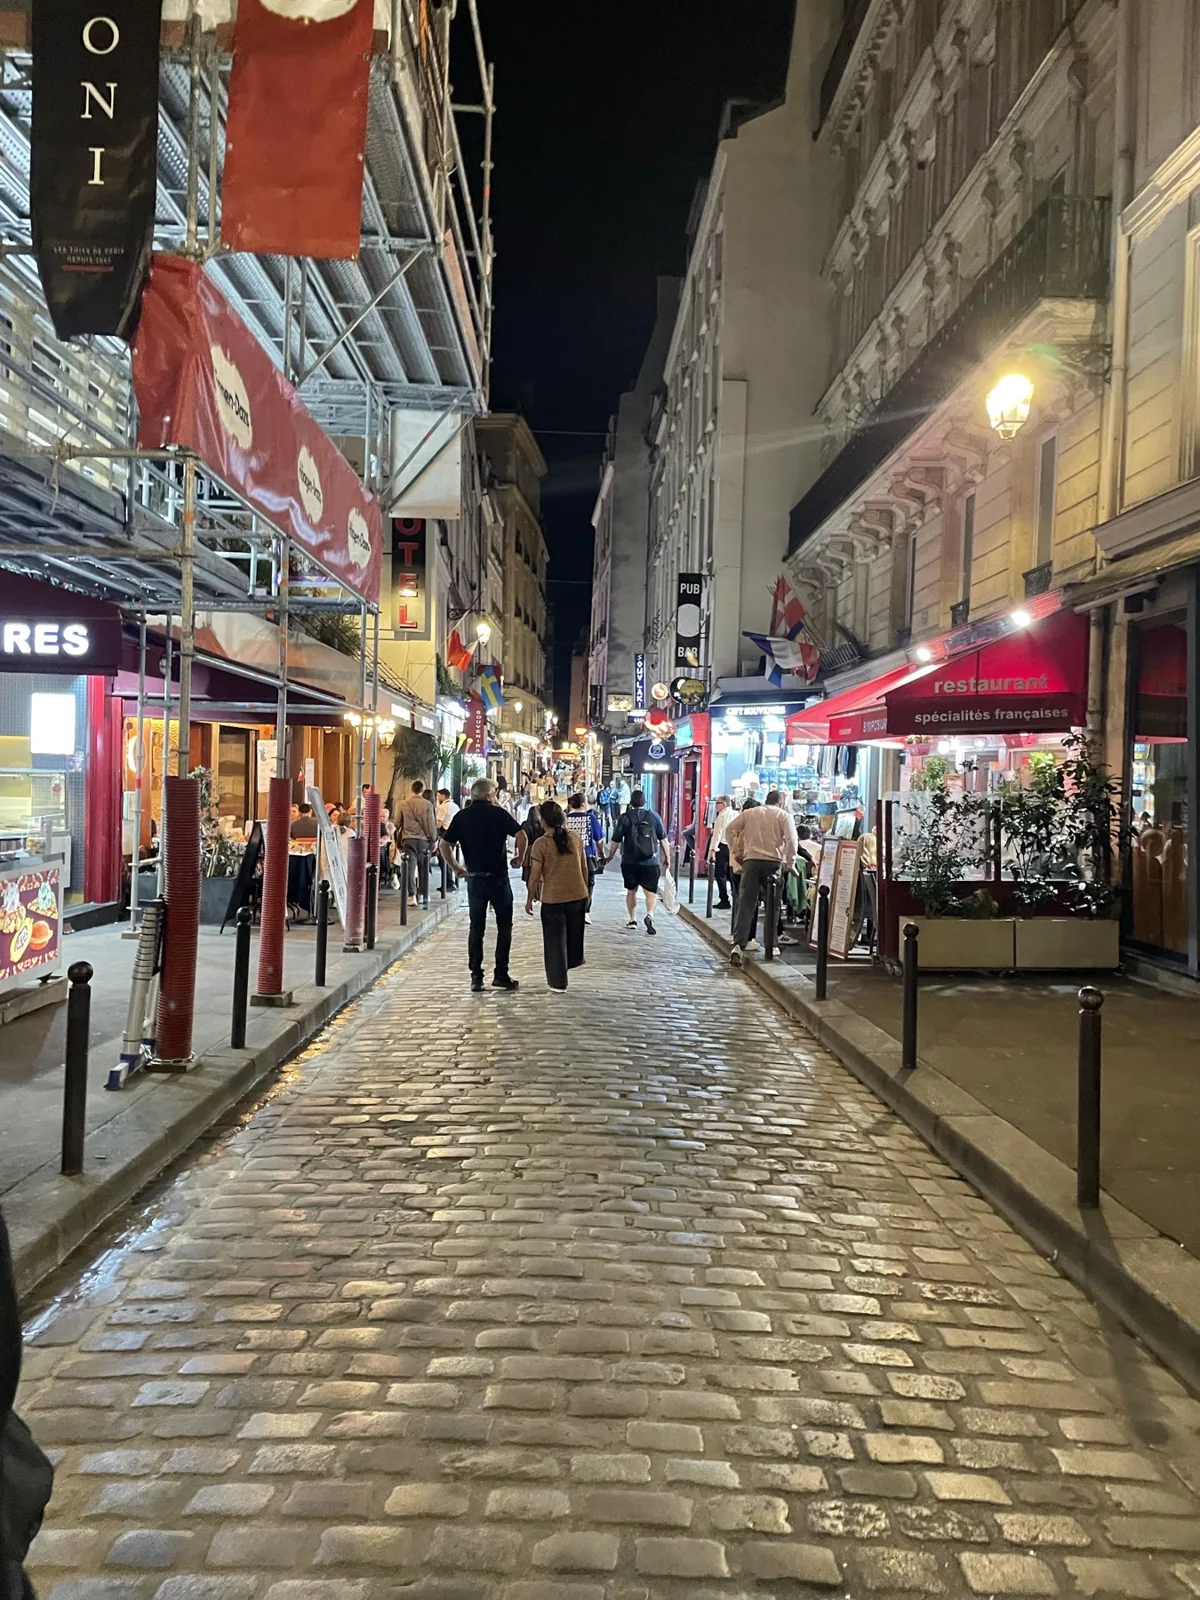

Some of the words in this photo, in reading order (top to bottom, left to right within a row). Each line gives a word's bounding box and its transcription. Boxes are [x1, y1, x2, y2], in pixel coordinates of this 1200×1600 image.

[81, 16, 120, 185] ONI
[680, 583, 700, 594] PUB
[4, 622, 89, 655] RES
[934, 674, 1048, 693] restaurant
[914, 709, 990, 725] spécialités
[995, 708, 1068, 721] françaises
